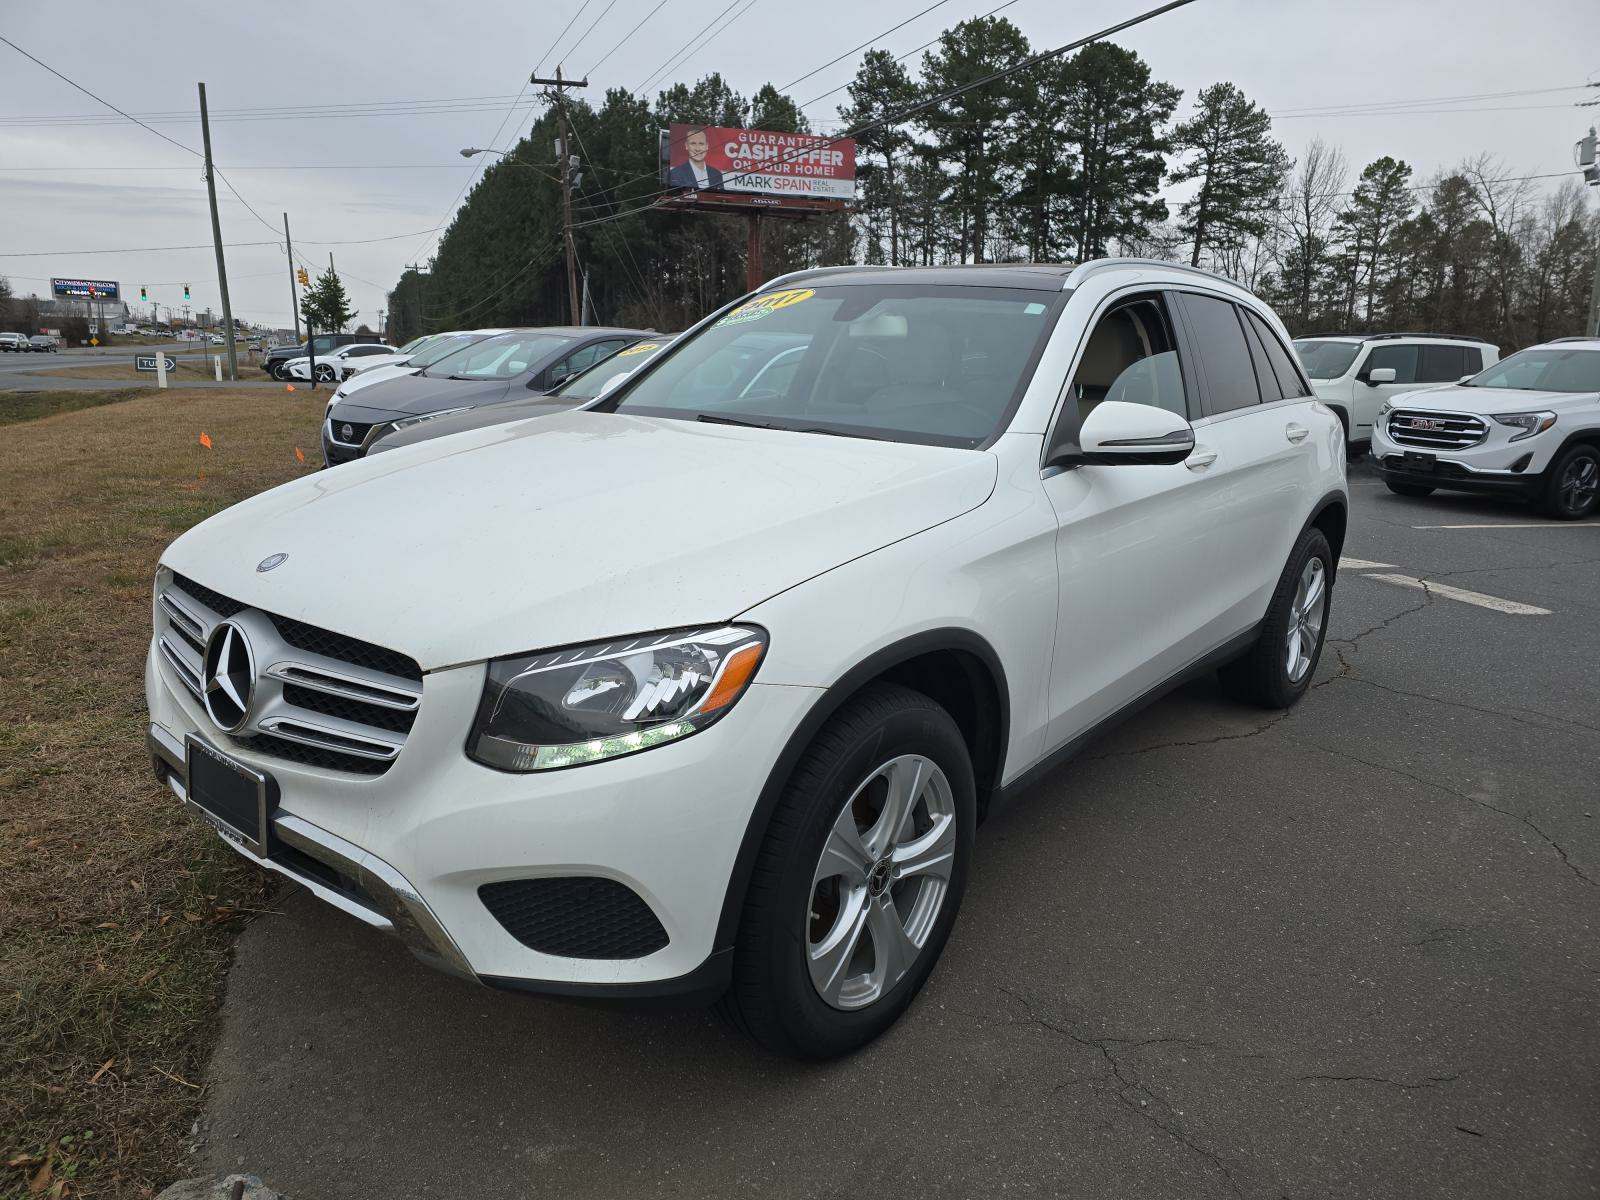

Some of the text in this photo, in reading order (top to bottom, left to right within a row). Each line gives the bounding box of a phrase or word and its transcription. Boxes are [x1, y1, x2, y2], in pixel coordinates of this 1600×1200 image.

[738, 132, 830, 149] GUARANTEED
[724, 142, 844, 166] CASH OFFER
[733, 160, 834, 176] ON YOUR HOME!
[734, 174, 812, 191] MARK SPAIN
[1411, 418, 1445, 432] GMC
